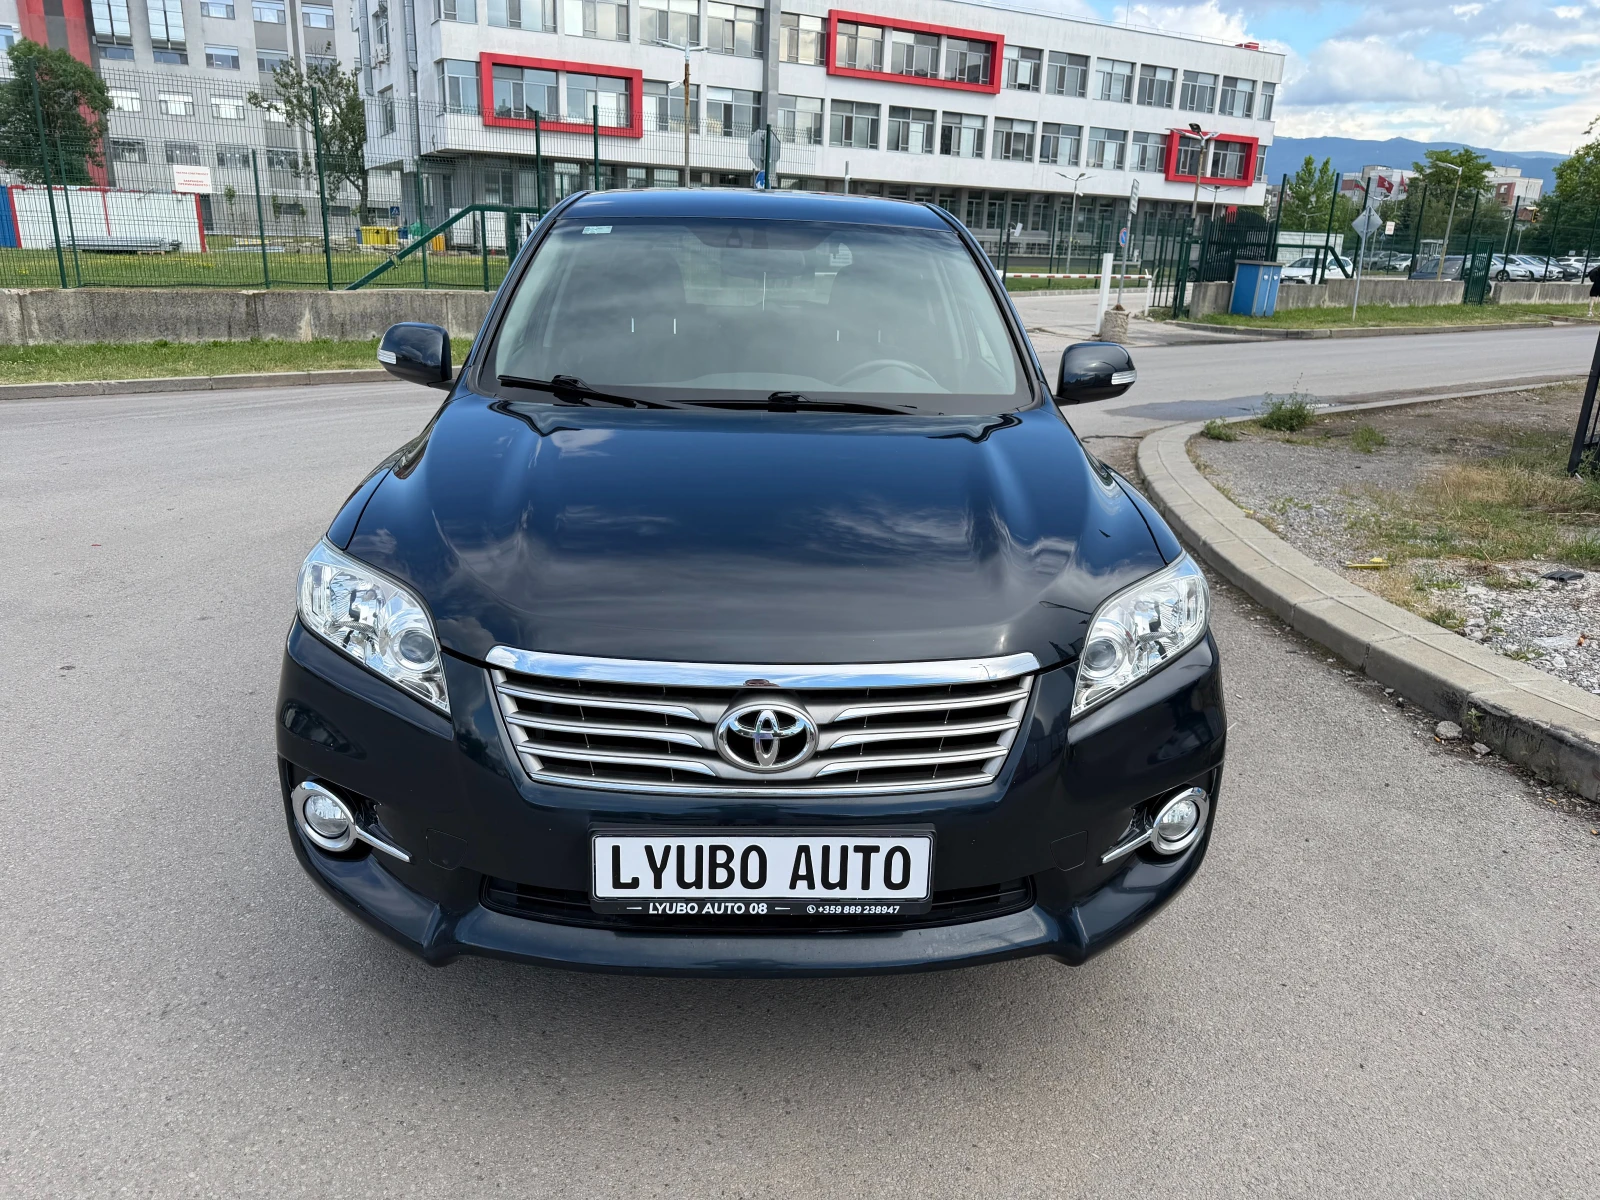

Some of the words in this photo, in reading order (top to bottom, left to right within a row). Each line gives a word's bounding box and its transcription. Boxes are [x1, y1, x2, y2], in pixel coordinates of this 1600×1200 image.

[611, 844, 768, 890] LYUBO
[788, 844, 911, 891] AUTO
[648, 902, 699, 915] LYUBO
[702, 902, 746, 915] AUTO
[748, 902, 768, 915] 08
[817, 905, 842, 914] +359
[843, 905, 862, 914] 889
[863, 905, 900, 914] 238947
